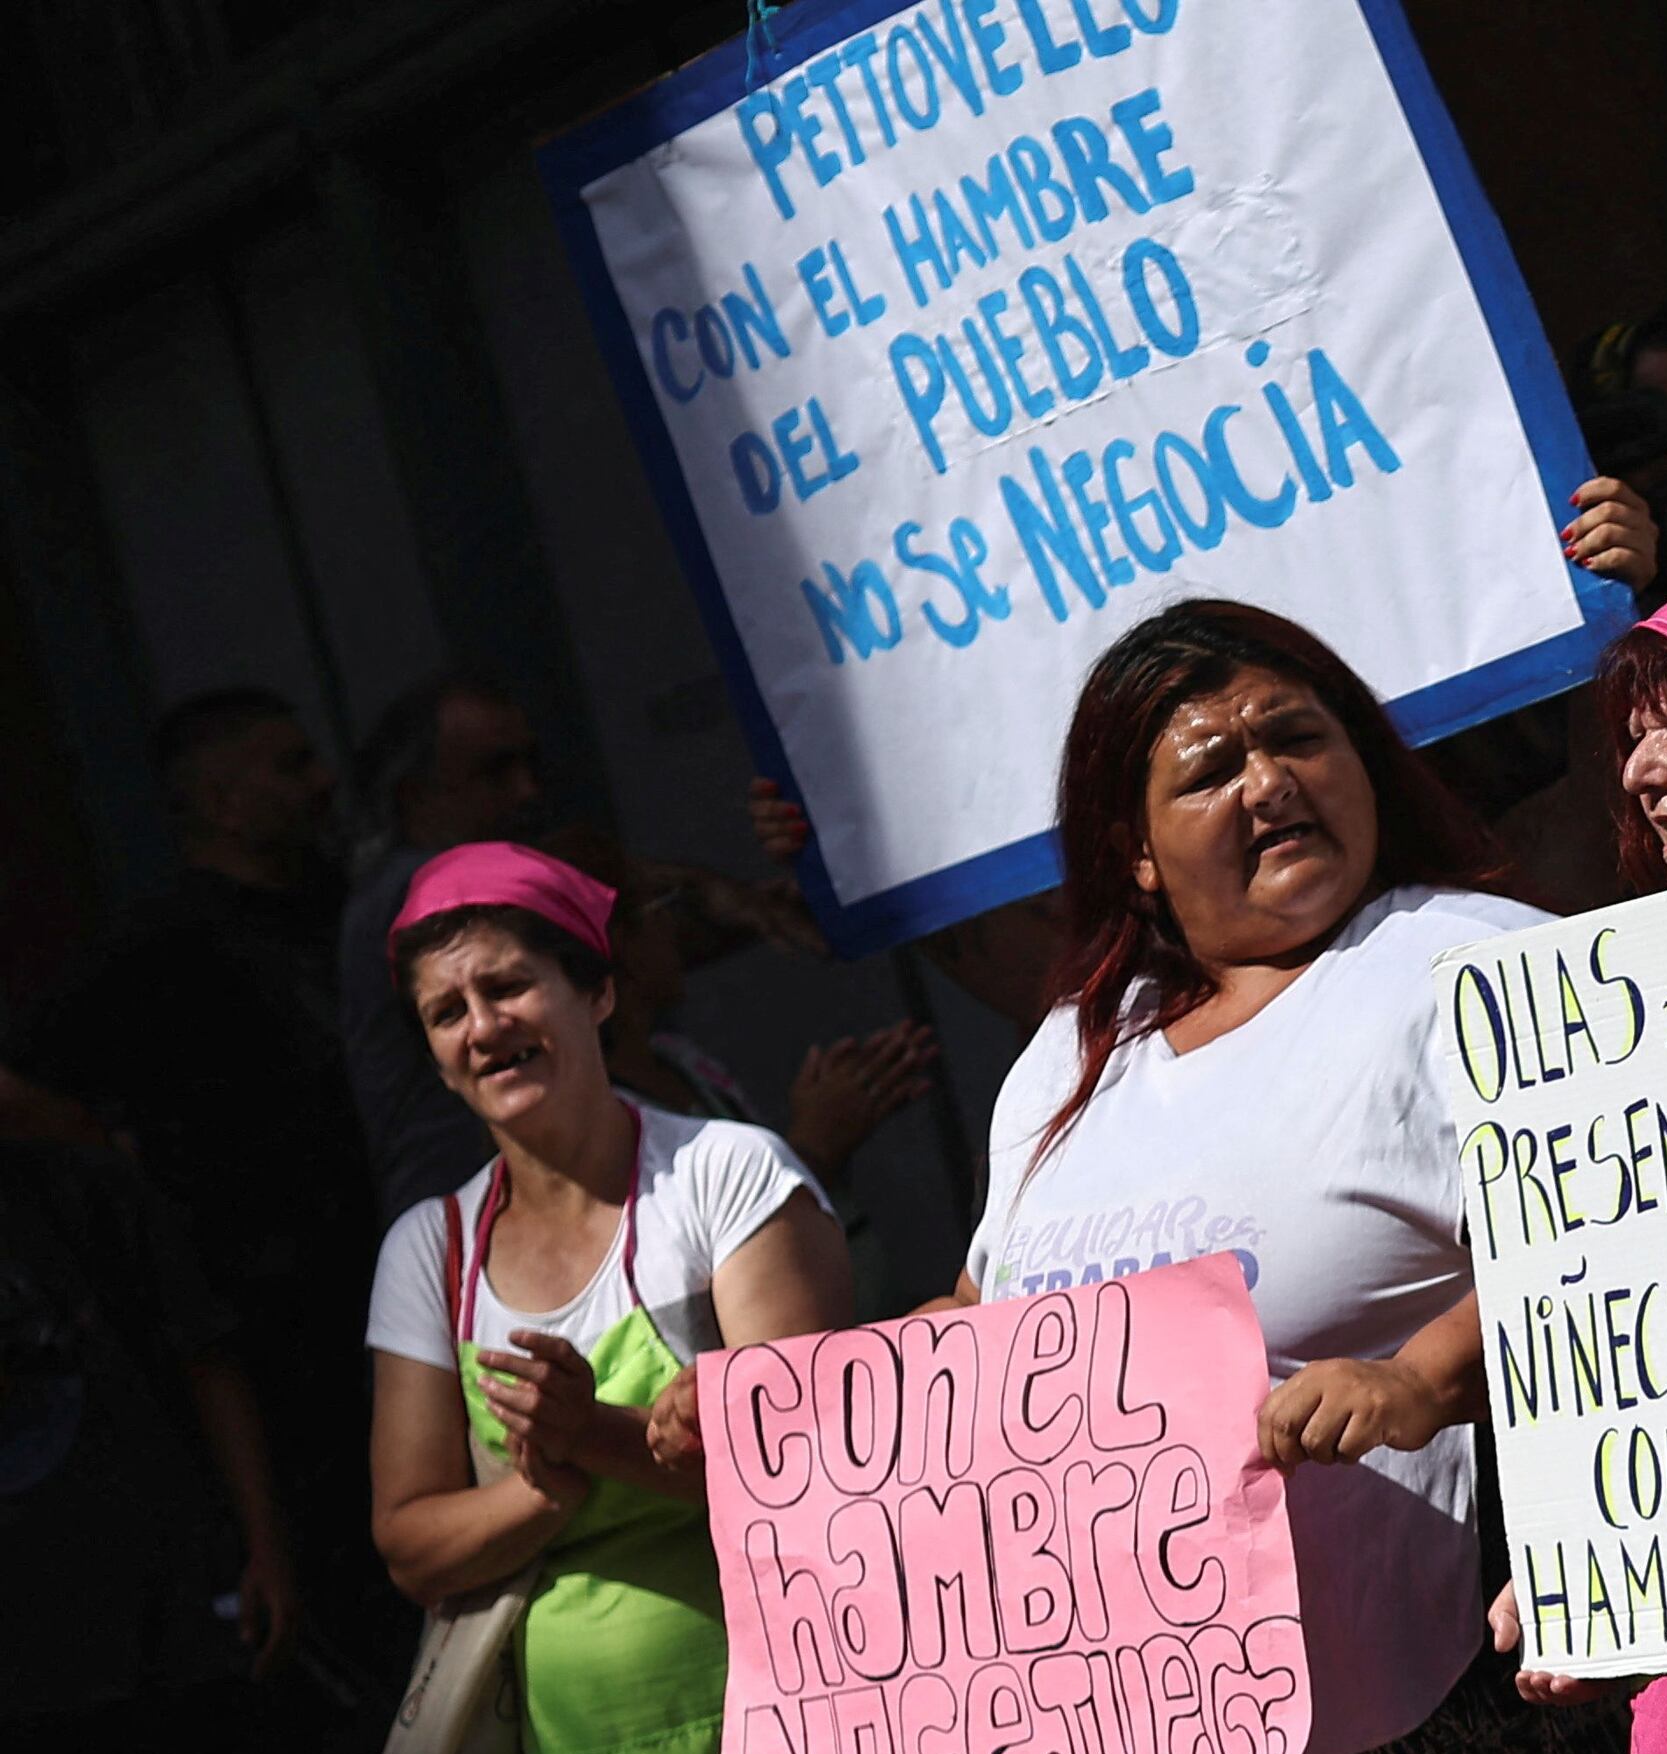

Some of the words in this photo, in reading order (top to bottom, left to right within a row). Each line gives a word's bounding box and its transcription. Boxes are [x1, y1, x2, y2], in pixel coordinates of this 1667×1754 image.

[650, 262, 789, 401] CON
[797, 238, 886, 340] EL
[882, 86, 1196, 307] HAMBRE
[729, 395, 860, 516] DEL
[889, 236, 1201, 473] PUEBLO
[1452, 927, 1646, 1104] OLLAS
